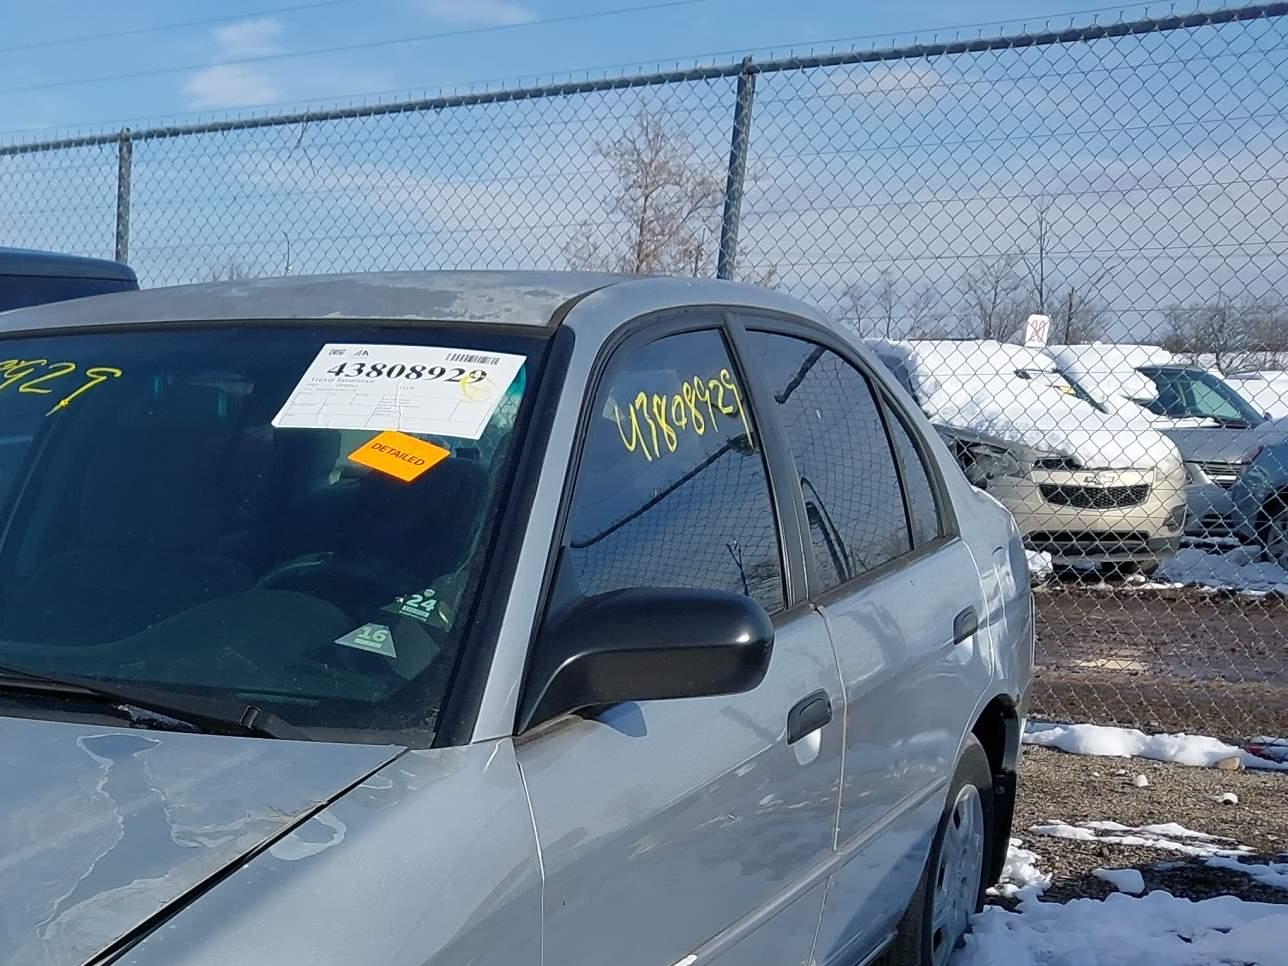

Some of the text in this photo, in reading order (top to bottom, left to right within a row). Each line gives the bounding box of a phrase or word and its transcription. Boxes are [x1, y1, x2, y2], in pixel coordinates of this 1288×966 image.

[326, 362, 488, 384] 43808929
[614, 368, 754, 462] 43808929
[371, 442, 425, 466] DETAILED
[405, 594, 437, 612] 24
[358, 626, 386, 642] 16
